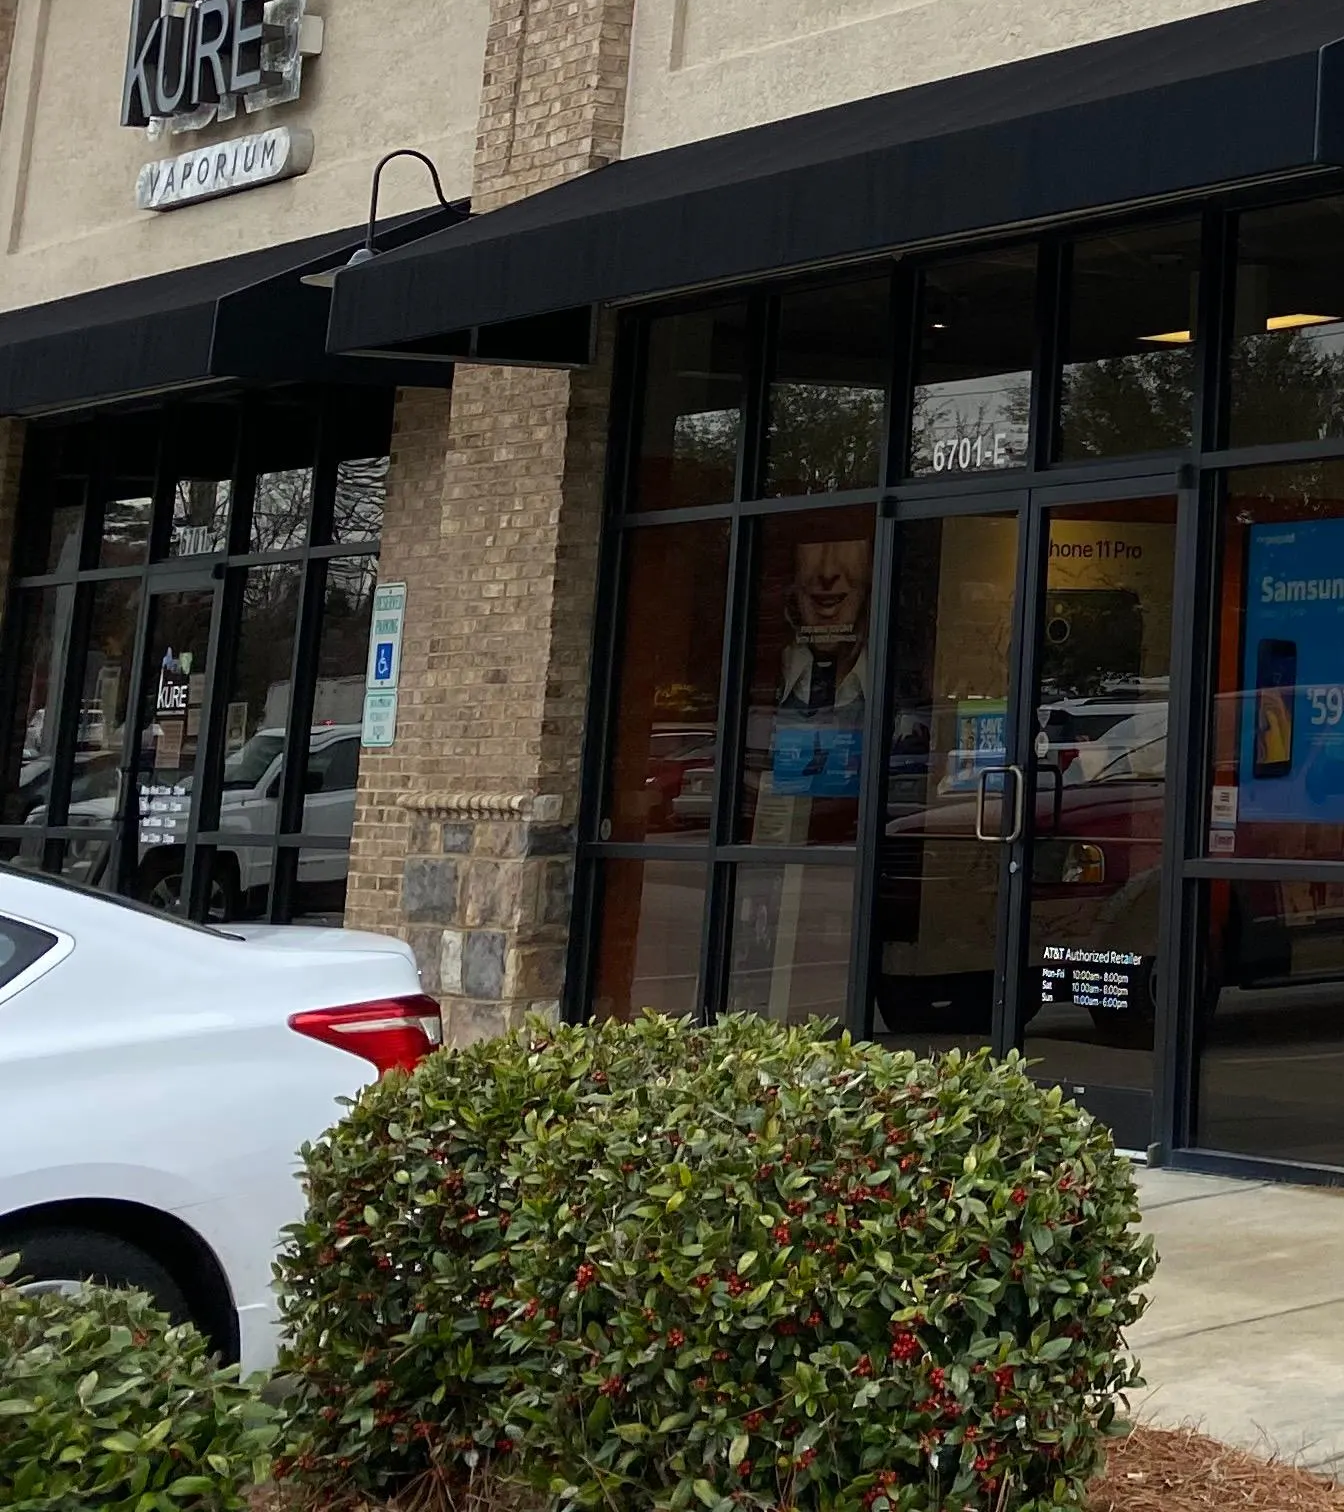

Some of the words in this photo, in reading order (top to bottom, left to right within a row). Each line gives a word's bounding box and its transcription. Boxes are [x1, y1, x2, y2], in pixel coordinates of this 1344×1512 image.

[148, 139, 278, 200] VAPORIUM
[933, 433, 1007, 472] 6701-E
[1049, 539, 1093, 558] hone
[1096, 539, 1111, 558] 11
[1114, 540, 1142, 559] Pro
[1043, 946, 1065, 959] AT&T
[1065, 948, 1110, 964] Authorized
[1110, 951, 1142, 966] Retailer
[1042, 992, 1053, 1002] Sun
